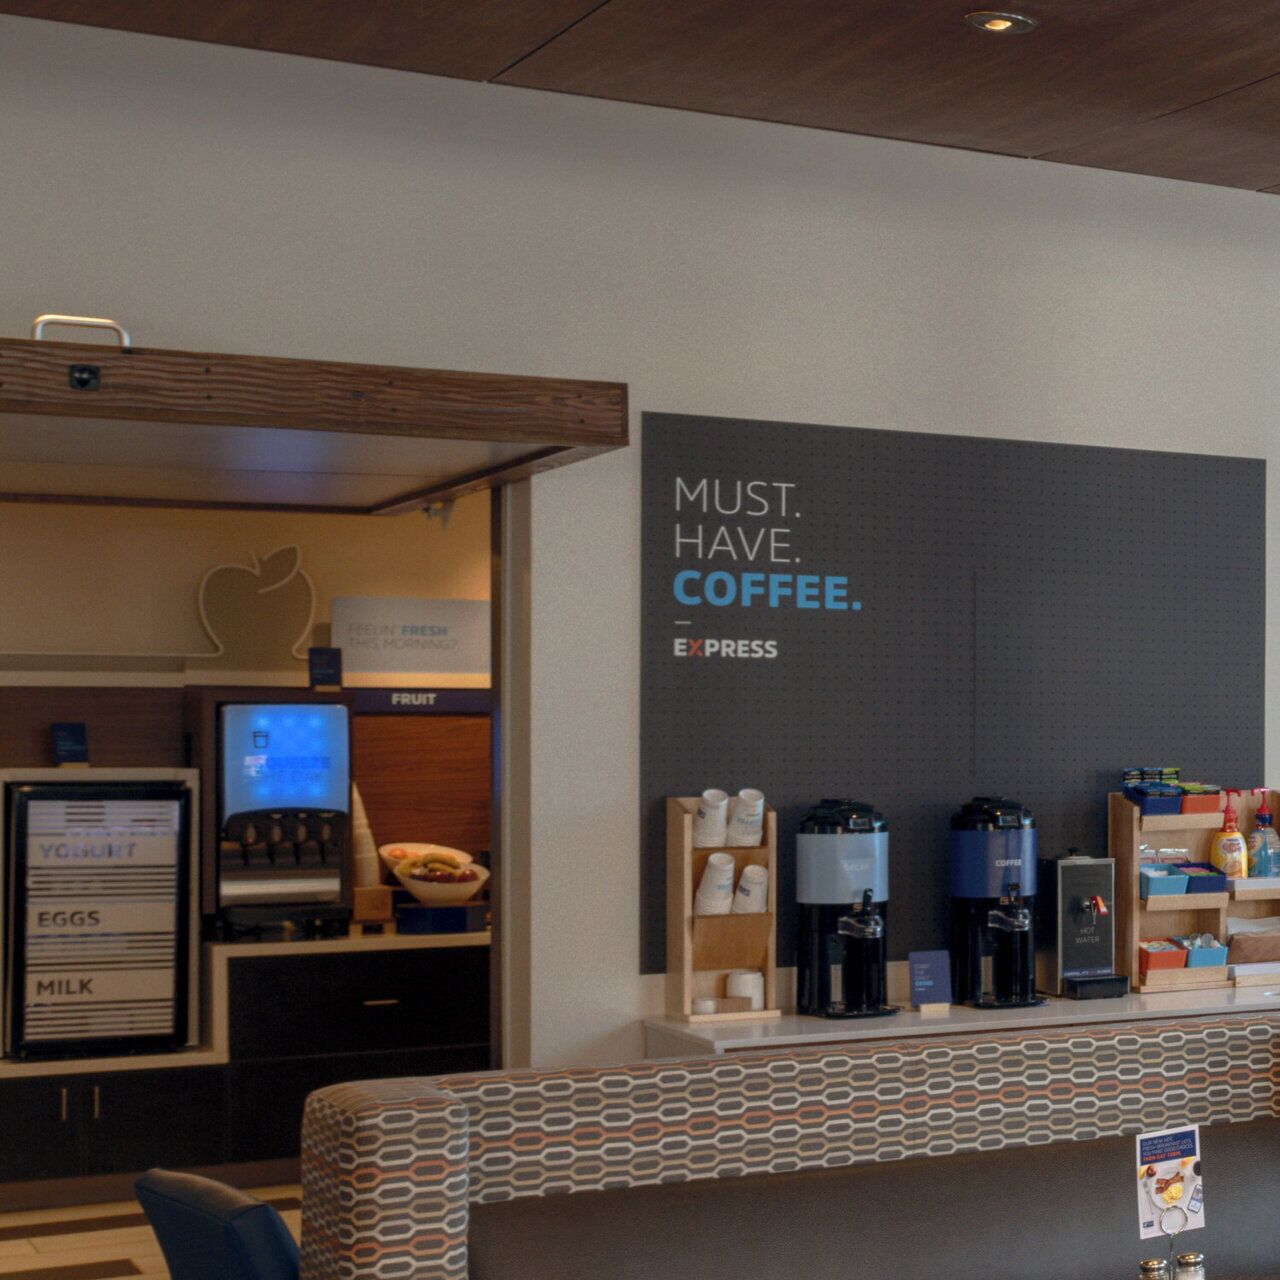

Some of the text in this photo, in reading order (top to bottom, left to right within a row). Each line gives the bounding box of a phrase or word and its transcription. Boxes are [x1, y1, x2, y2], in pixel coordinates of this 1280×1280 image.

[676, 476, 801, 518] MUST.
[676, 523, 802, 564] HAVE.
[673, 569, 862, 611] COFFEE.
[401, 624, 448, 637] FRESH
[673, 637, 779, 659] EXPRESS
[391, 692, 438, 706] FRUIT
[258, 755, 332, 770] QUEEZE
[40, 842, 138, 860] YOGURT
[995, 858, 1023, 868] COFFEE
[37, 910, 101, 928] EGGS
[1075, 935, 1100, 944] WATER
[1080, 926, 1095, 935] HOT
[36, 977, 95, 996] MILK
